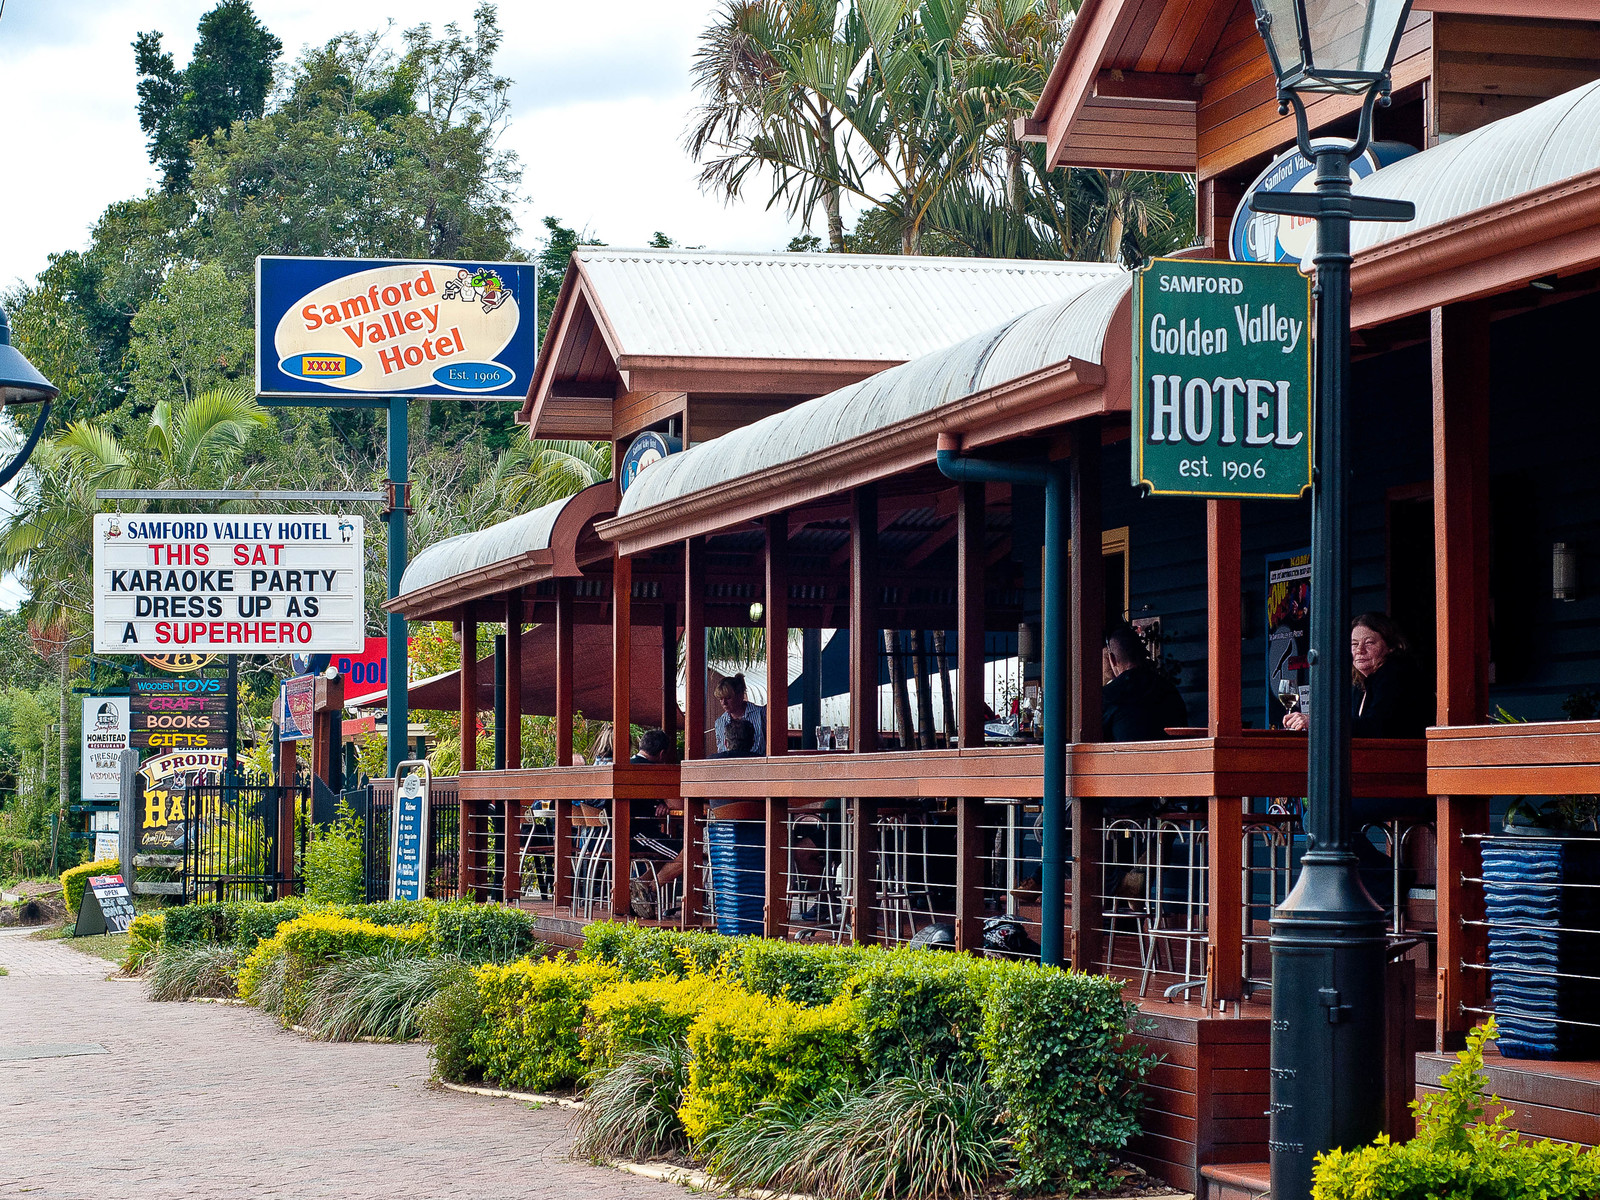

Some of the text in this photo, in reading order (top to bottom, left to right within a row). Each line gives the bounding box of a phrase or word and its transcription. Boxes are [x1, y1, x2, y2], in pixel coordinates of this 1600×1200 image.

[1264, 159, 1293, 192] Samford
[1159, 275, 1244, 295] SAMFORD
[302, 270, 436, 331] Samford
[342, 304, 439, 349] Valley
[1150, 303, 1303, 357] Golden Valley
[378, 328, 465, 375] Hotel
[306, 360, 342, 372] XXXX
[449, 368, 501, 383] Est. 1906
[1148, 374, 1304, 446] HOTEL
[1178, 455, 1266, 481] est. 1906
[127, 521, 332, 540] SAMFORD VALLEY HOTEL
[148, 544, 285, 566] THIS SAT
[111, 570, 337, 592] KARAOKE PARTY
[135, 595, 319, 618] DRESS UP AS
[121, 621, 312, 644] A SUPERHERO
[338, 657, 387, 684] Pool
[137, 679, 221, 692] WOODEN TOYS
[148, 697, 209, 711] CRAFT
[146, 715, 211, 729] BOOKS
[87, 733, 127, 742] HOMESTEAD
[148, 733, 209, 747] GIFTS
[160, 754, 243, 773] PRODU
[104, 888, 119, 897] OPEN
